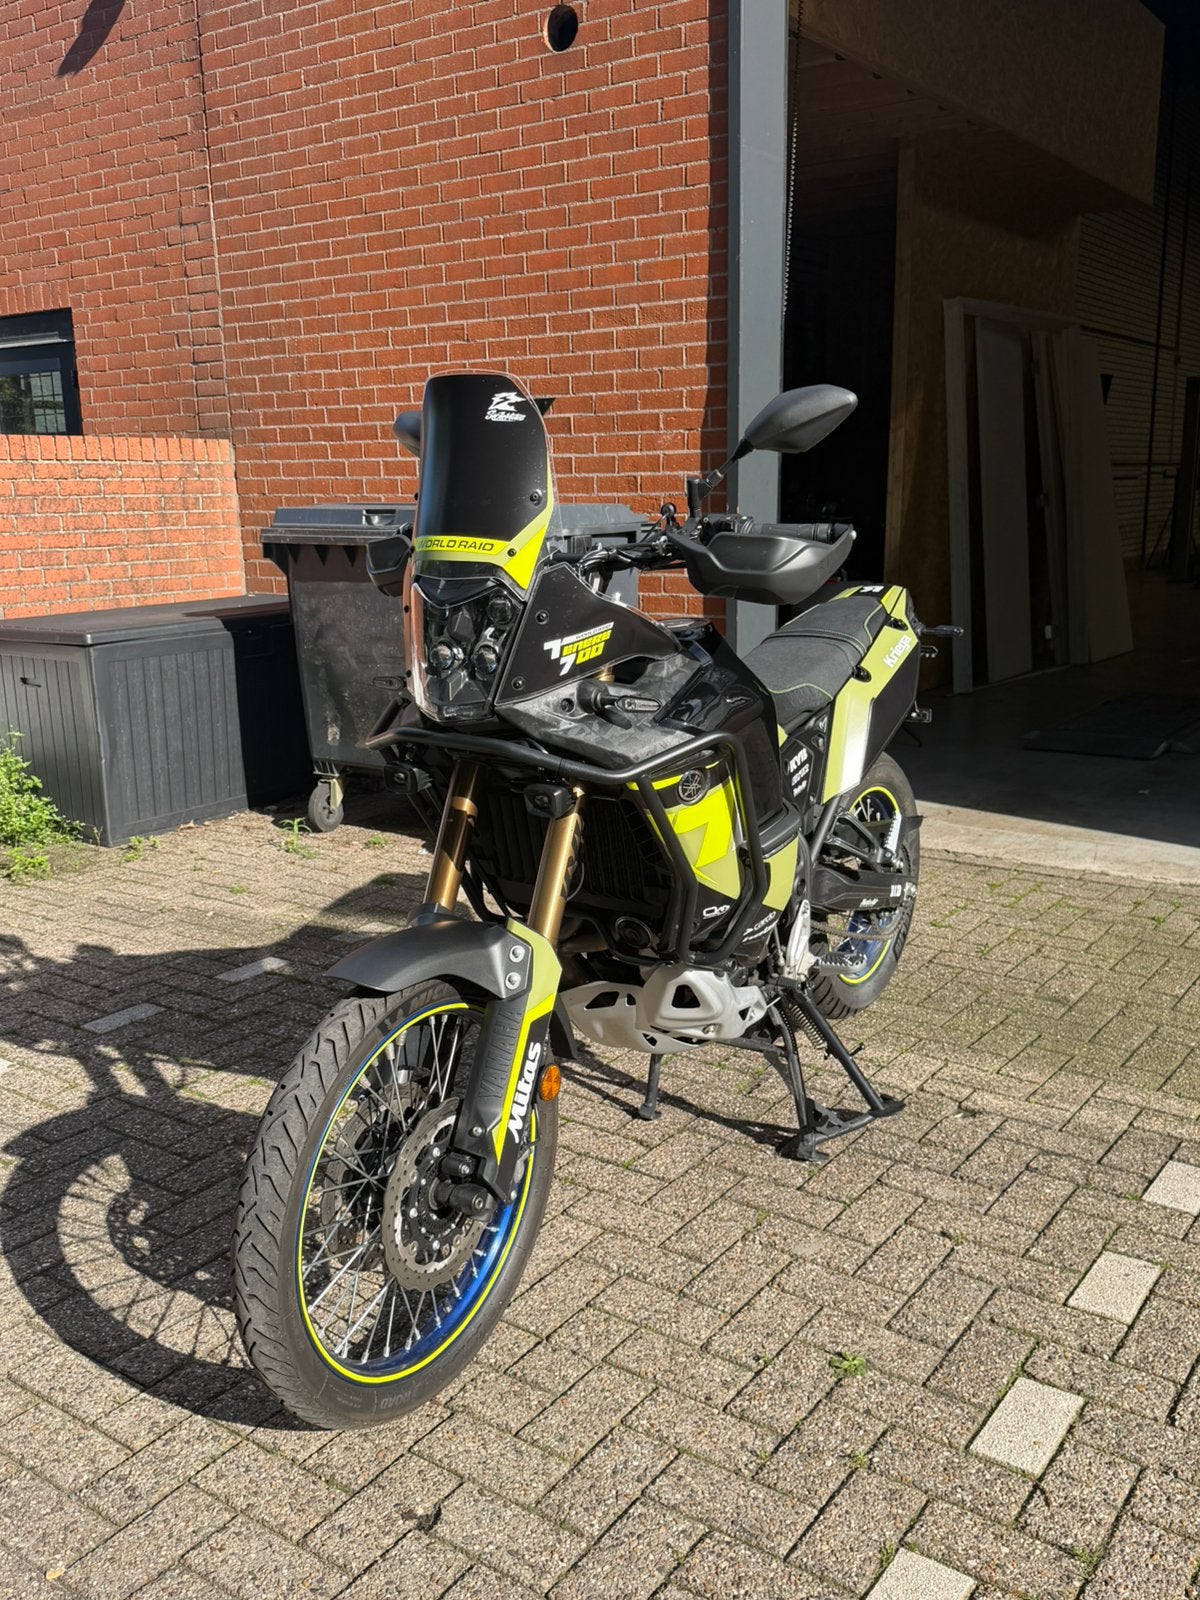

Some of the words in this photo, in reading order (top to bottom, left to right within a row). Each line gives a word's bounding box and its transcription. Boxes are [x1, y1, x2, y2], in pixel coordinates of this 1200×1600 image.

[417, 539, 457, 549] WORLD
[458, 540, 495, 552] RAID
[559, 641, 606, 677] 700
[883, 635, 912, 669] Kriega
[479, 1007, 523, 1099] YAMAHA
[507, 1041, 542, 1144] Mitas
